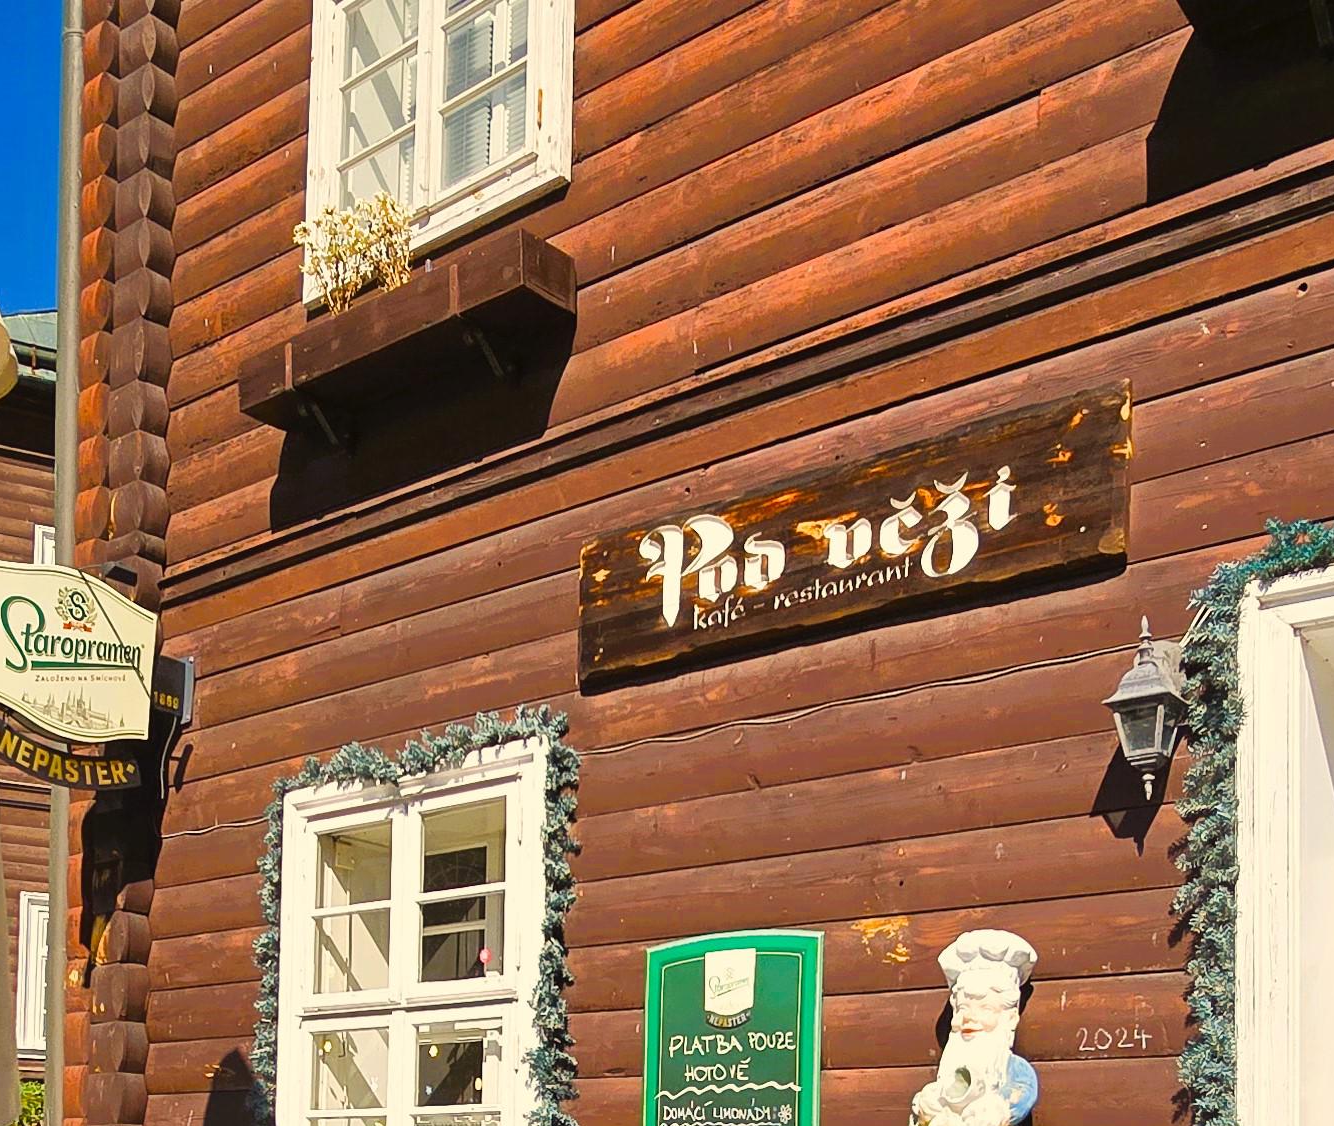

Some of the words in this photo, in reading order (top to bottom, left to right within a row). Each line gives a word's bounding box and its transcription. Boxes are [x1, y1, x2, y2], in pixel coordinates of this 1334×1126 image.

[639, 513, 787, 628] Pod
[823, 465, 1017, 578] věži
[693, 593, 746, 631] kafé
[773, 557, 914, 610] restaurant
[0, 595, 143, 674] Staropramen
[668, 1034, 743, 1058] PLATBA
[747, 1031, 796, 1051] POUZE
[1075, 1024, 1153, 1052] 2024
[663, 1100, 714, 1122] DOMÁCÍ
